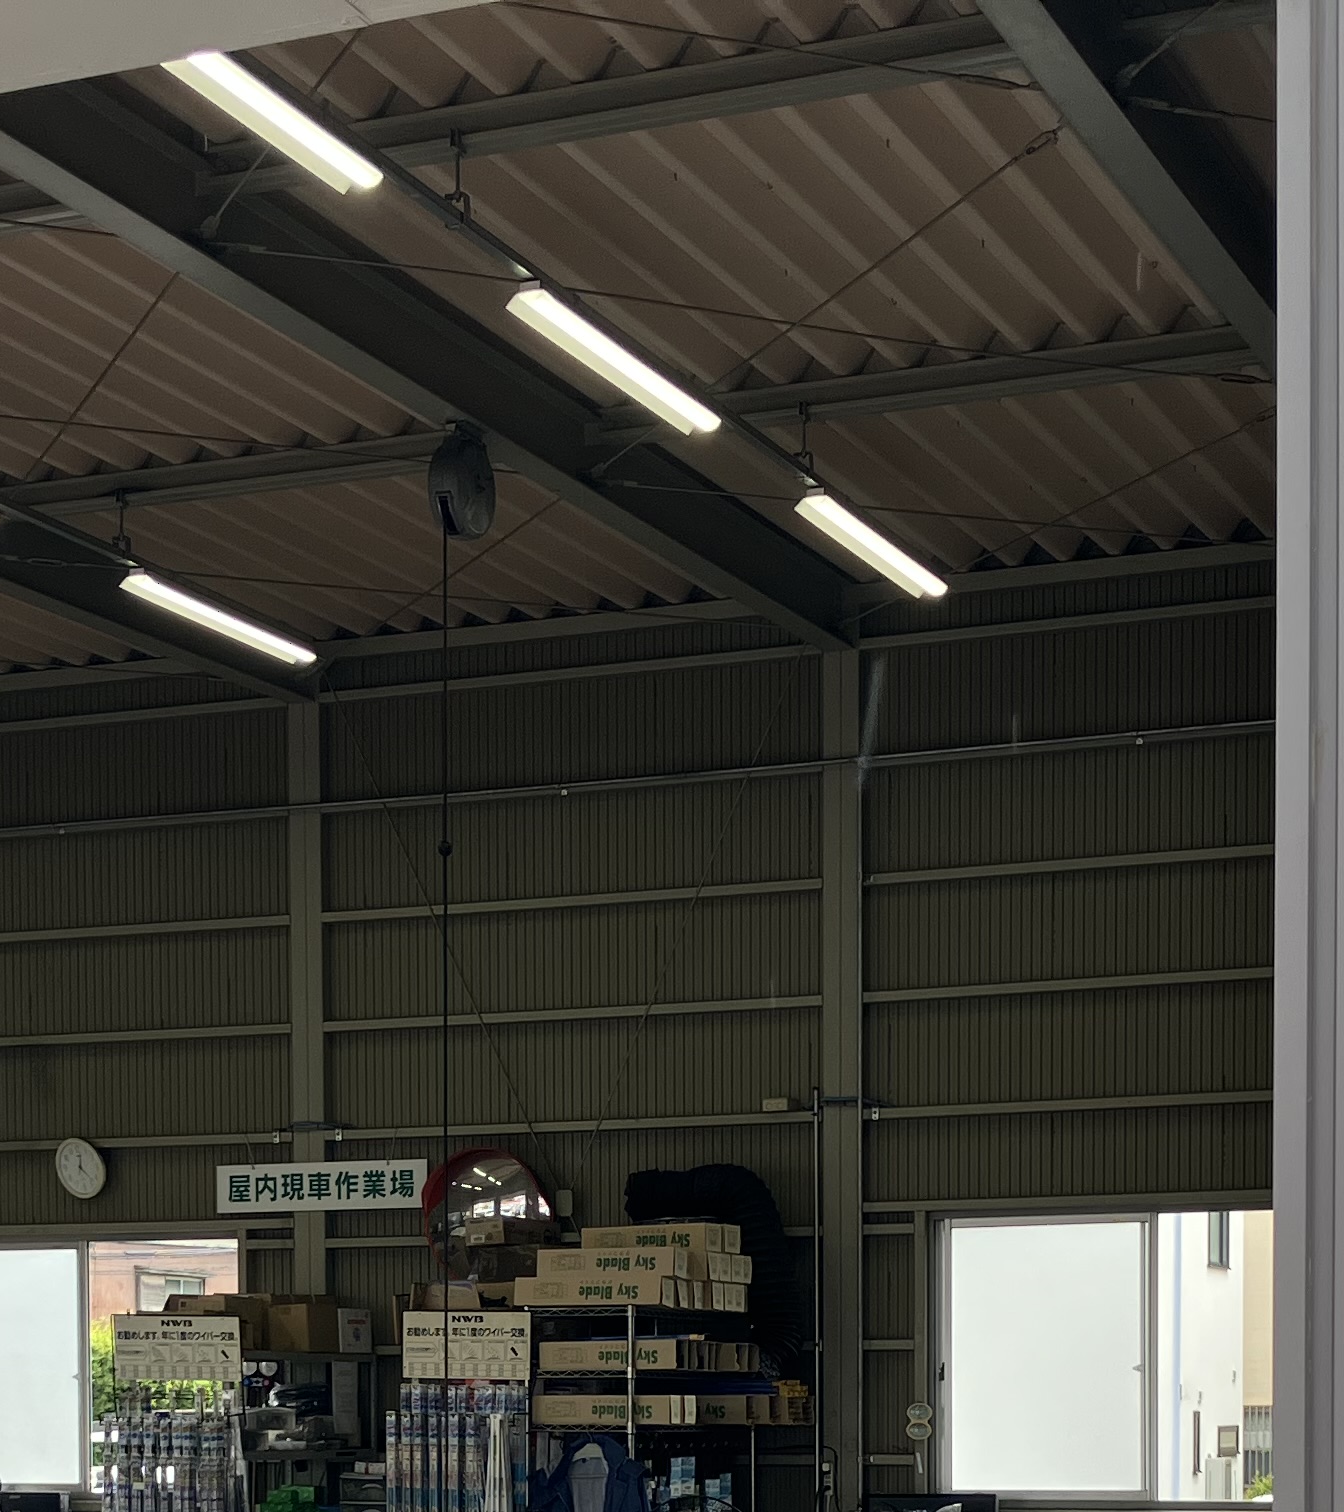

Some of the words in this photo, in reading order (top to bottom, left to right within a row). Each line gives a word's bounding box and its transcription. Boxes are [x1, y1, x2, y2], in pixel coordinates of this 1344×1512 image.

[228, 1169, 416, 1203] 屋内現車作業場
[596, 1257, 630, 1271] Blade
[634, 1254, 656, 1271] Sky
[578, 1285, 613, 1300] Blade
[617, 1284, 639, 1300] Sky
[161, 1319, 193, 1327] NWB
[451, 1315, 484, 1323] NWB
[636, 1348, 658, 1364] Sky
